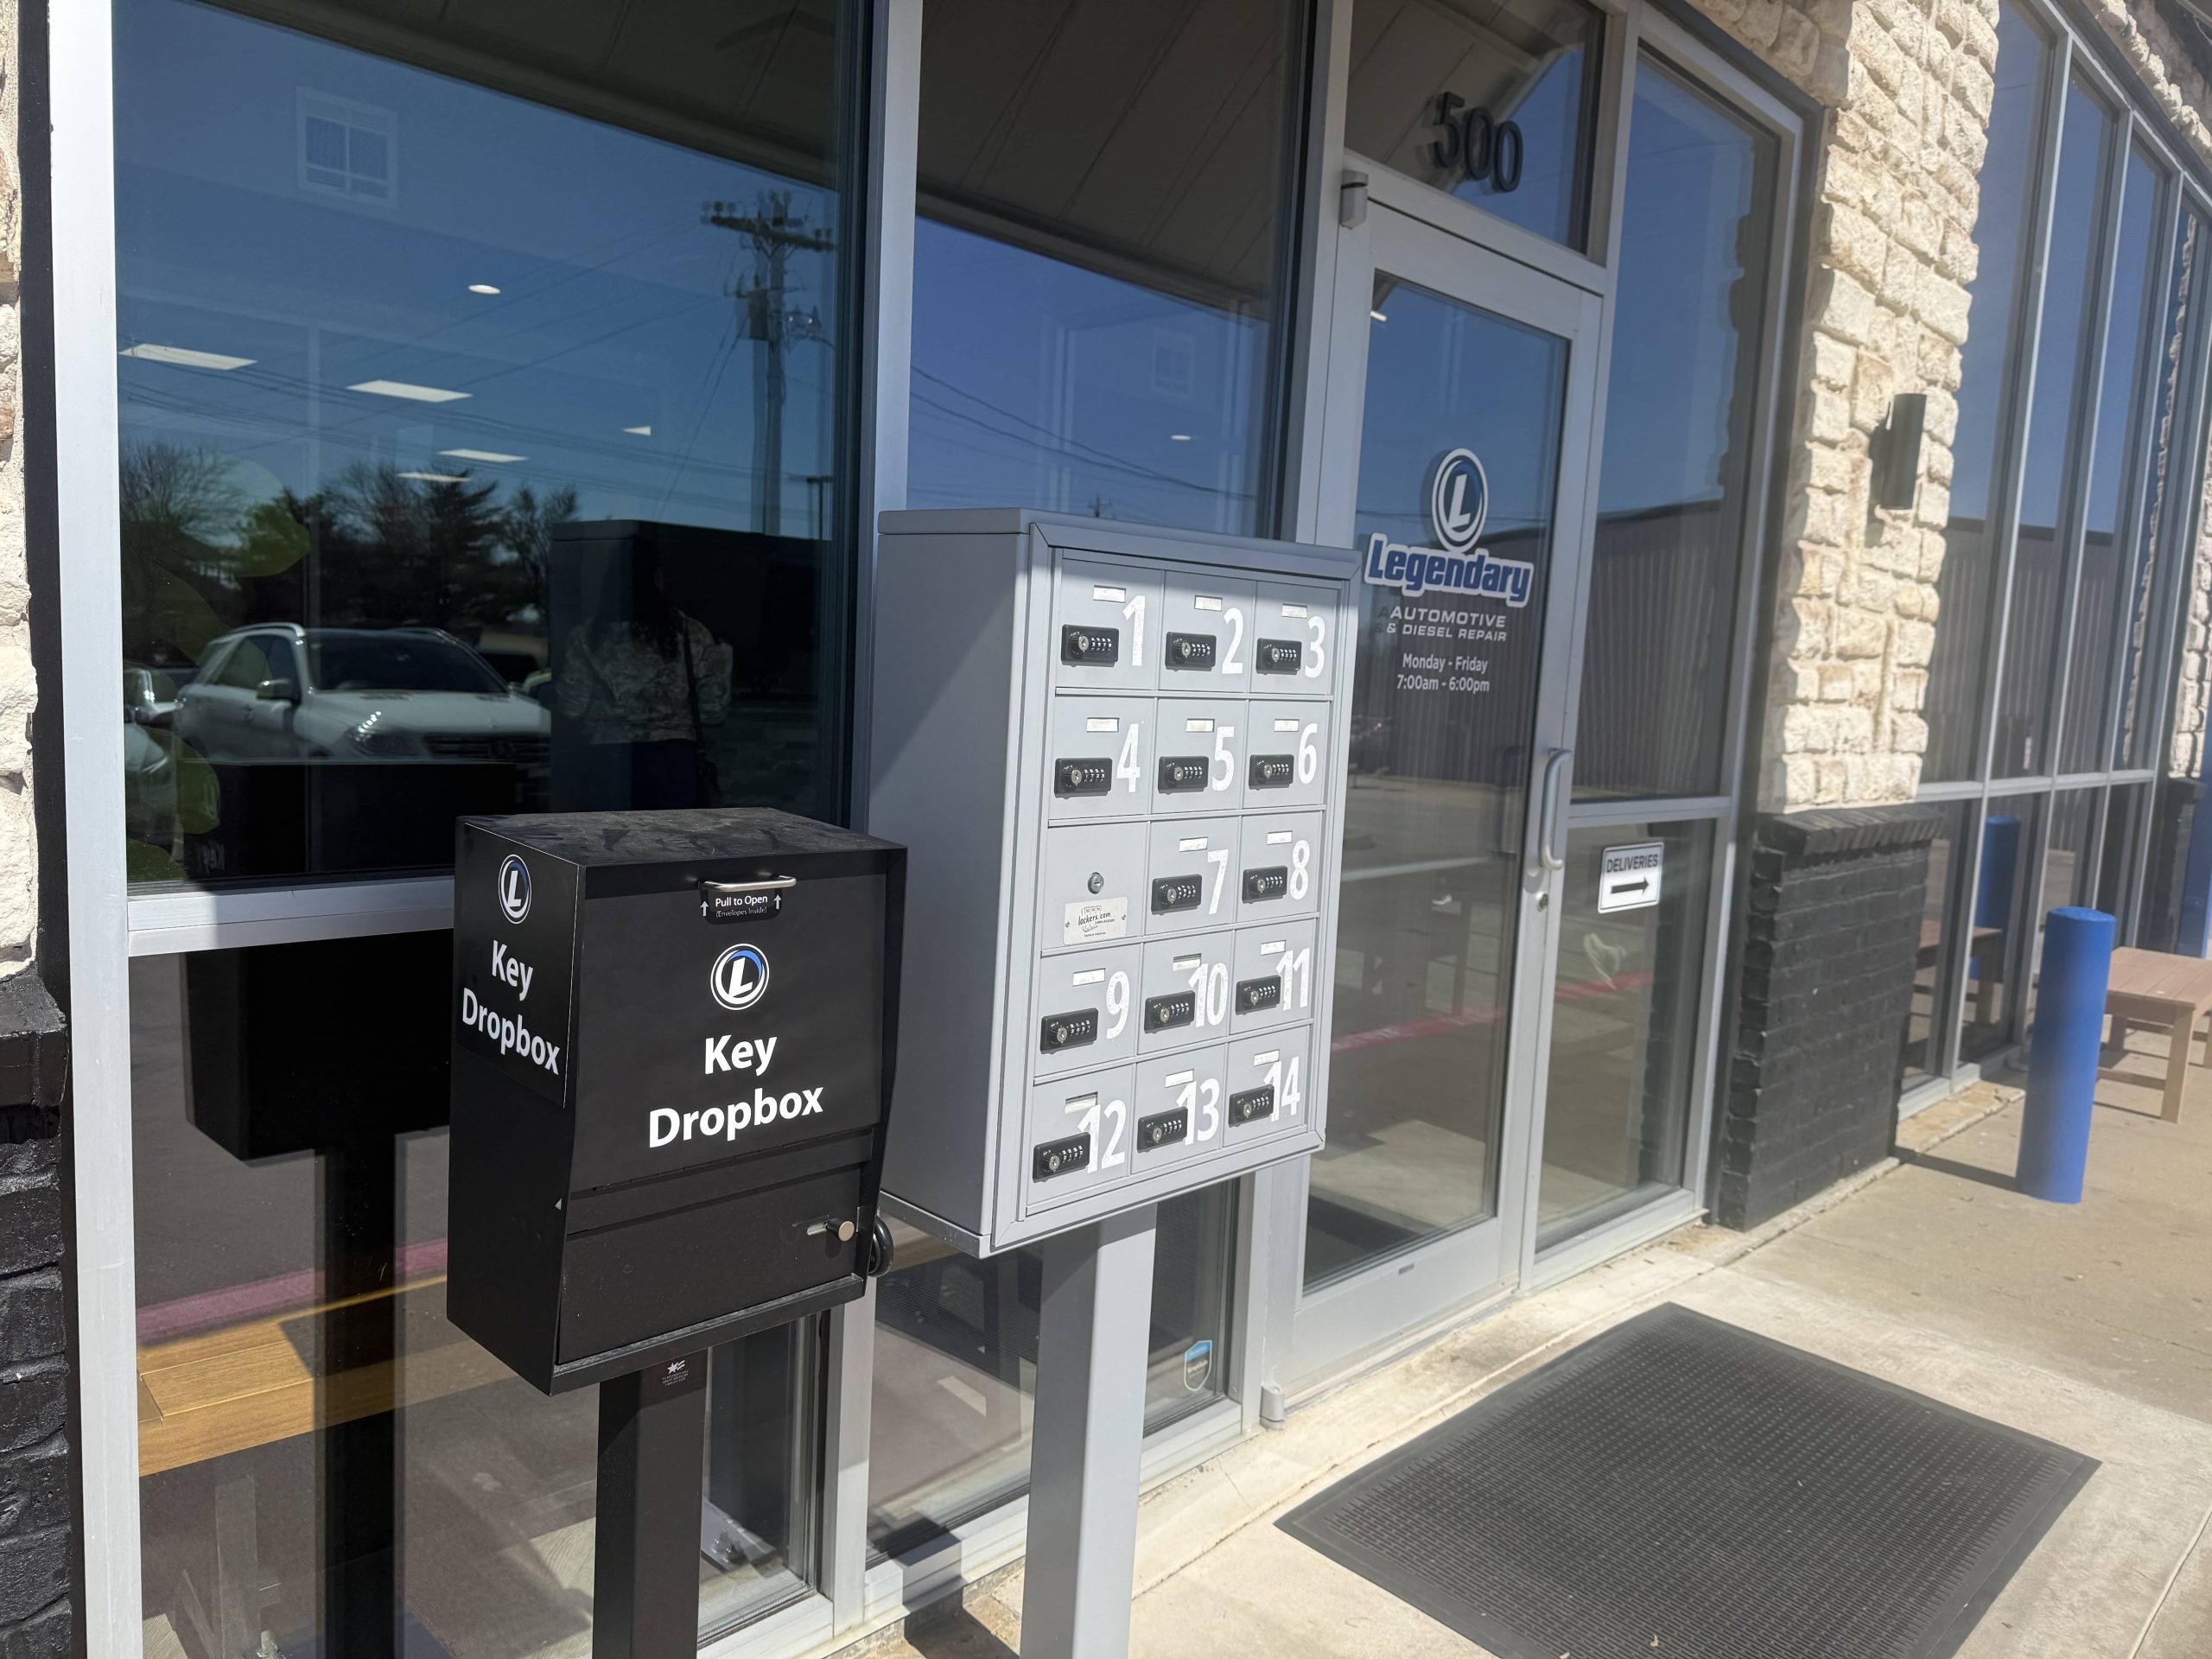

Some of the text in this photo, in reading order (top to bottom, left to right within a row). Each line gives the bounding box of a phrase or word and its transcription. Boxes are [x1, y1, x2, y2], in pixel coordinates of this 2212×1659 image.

[1431, 92, 1522, 193] 500
[1365, 535, 1533, 606] Legendary
[1122, 595, 1146, 666] 1
[1222, 607, 1244, 675] 2
[1305, 616, 1325, 678] 3
[1386, 622, 1507, 642] & DIESEL REPAIR
[1389, 605, 1507, 628] AUTOMOTIVE
[1396, 674, 1439, 690] 7:00am
[1449, 677, 1490, 694] 6:00pm
[1402, 652, 1446, 673] Monday
[1455, 656, 1488, 674] Friday
[1116, 723, 1141, 792] 4
[1211, 726, 1235, 791] 5
[1298, 723, 1318, 784] 6
[1208, 849, 1229, 914] 7
[1289, 840, 1310, 900] 8
[1606, 854, 1659, 873] DELIVERIES
[715, 897, 732, 907] Pull
[744, 895, 768, 906] Open
[1078, 912, 1111, 925] lockers.com
[492, 940, 533, 1001] Key
[1187, 963, 1228, 1027] 10
[1275, 948, 1310, 1010] 11
[462, 987, 560, 1075] Dropbox
[1106, 971, 1130, 1039] 9
[704, 1034, 778, 1076] Key
[649, 1086, 823, 1148] Dropbox
[1176, 1078, 1219, 1147] 13
[1263, 1057, 1300, 1122] 14
[1077, 1099, 1126, 1173] 12
